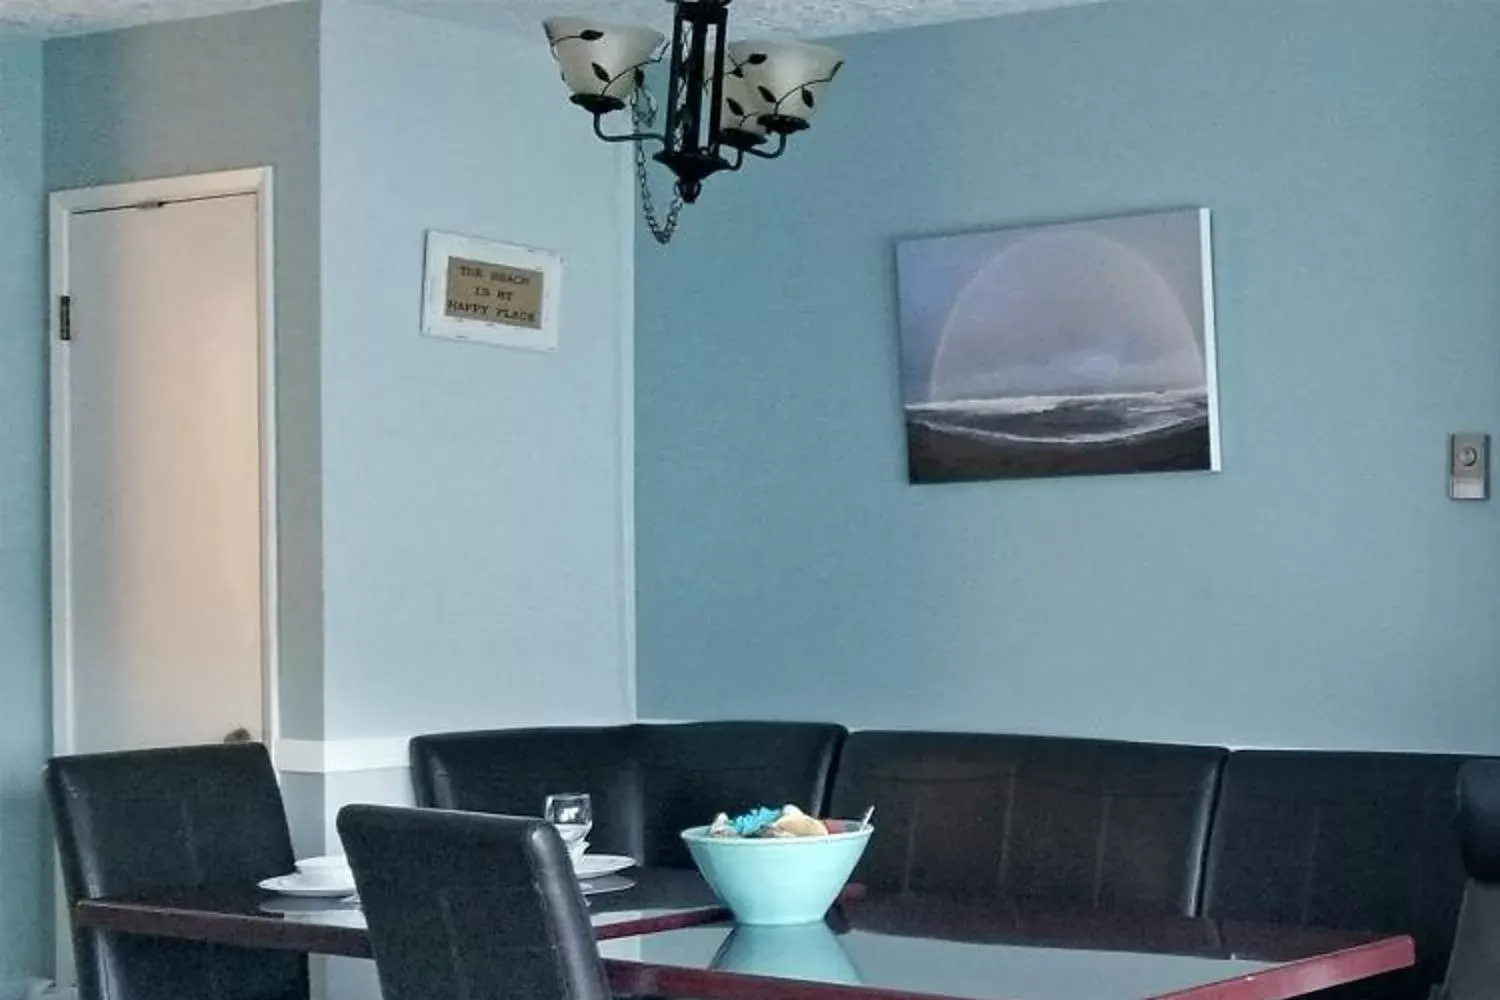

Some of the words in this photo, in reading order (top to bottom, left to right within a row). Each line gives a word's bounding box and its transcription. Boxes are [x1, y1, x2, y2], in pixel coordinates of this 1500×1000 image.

[460, 265, 483, 278] THE
[491, 271, 530, 285] BEACH
[475, 286, 490, 296] IS
[497, 290, 513, 302] MY
[448, 299, 488, 314] HAPPY
[496, 307, 535, 321] PLACE
